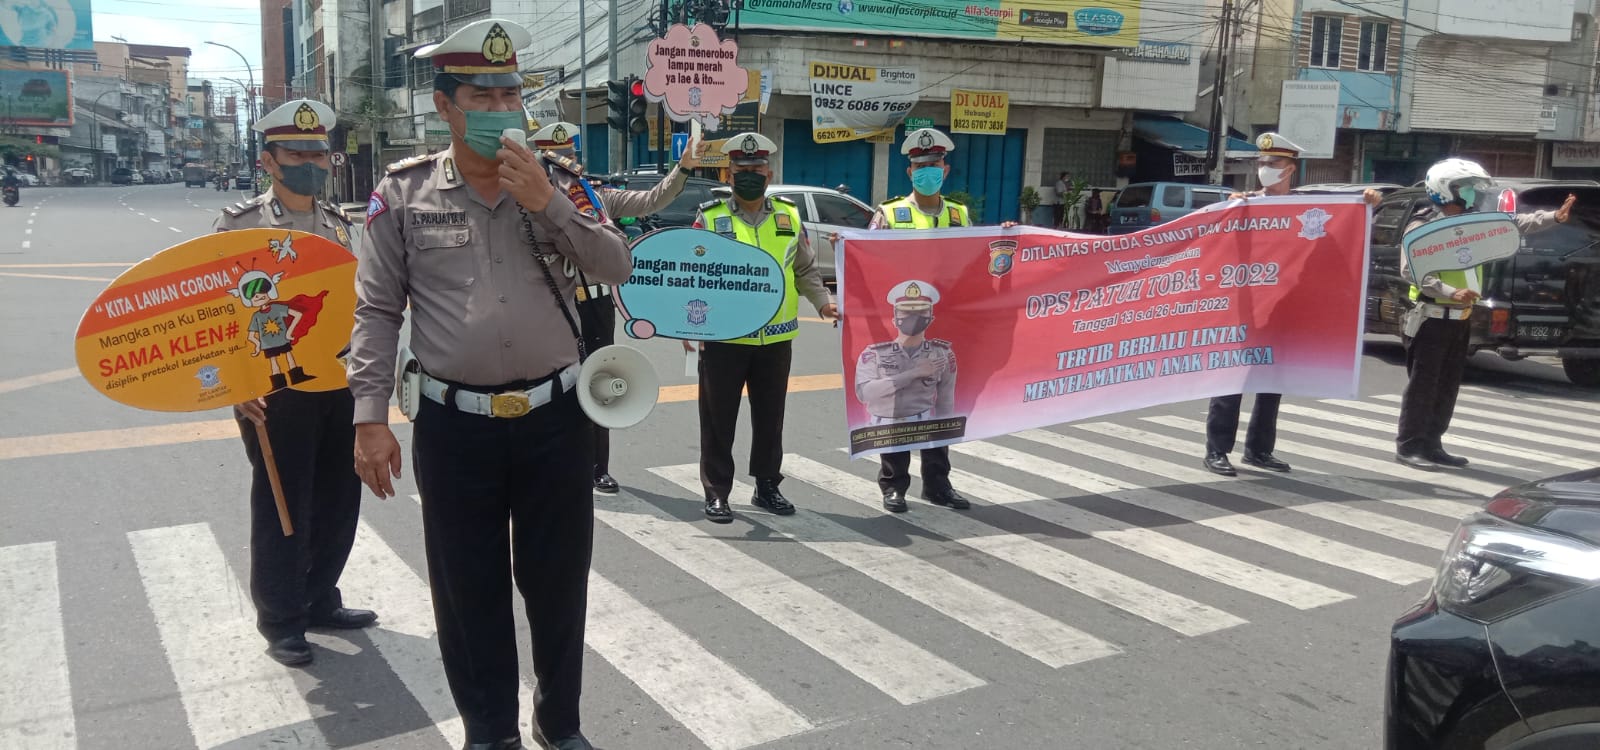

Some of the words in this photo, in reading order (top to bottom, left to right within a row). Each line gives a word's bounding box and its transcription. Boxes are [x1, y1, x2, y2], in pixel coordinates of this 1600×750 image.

[749, 0, 833, 10] @YamahaMesra
[858, 3, 958, 19] www.alfascorpii.co.id
[964, 5, 982, 16] Alfa
[983, 6, 1014, 20] Scorpii
[1033, 16, 1053, 25] Google
[1053, 17, 1066, 26] Play
[1076, 13, 1121, 23] CLASSY
[655, 44, 686, 59] Jangan
[688, 48, 734, 59] menerobos
[668, 59, 695, 72] lampu
[697, 61, 723, 72] merah
[814, 64, 871, 80] DIJUAL
[665, 74, 676, 86] ya
[678, 73, 691, 84] lae
[693, 73, 700, 84] &
[814, 83, 853, 96] LINCE
[815, 98, 845, 109] 0852
[848, 100, 879, 111] 6086
[882, 102, 912, 111] 7669
[955, 93, 970, 106] DI
[973, 94, 1005, 109] JUAL
[964, 110, 991, 118] Hubungi
[1021, 242, 1089, 262] DITLANTAS
[1092, 236, 1141, 253] POLDA
[1143, 227, 1194, 248] SUMUT
[1198, 221, 1222, 237] DAN
[1223, 217, 1292, 234] JAJARAN
[1412, 242, 1445, 258] Jangan
[1446, 231, 1487, 249] melawan
[632, 256, 676, 273] Jangan
[679, 261, 770, 278] menggunakan
[667, 276, 696, 288] saat
[698, 276, 779, 293] berkendara..
[1026, 291, 1071, 319] OPS
[1072, 278, 1146, 313] PATUH
[1147, 269, 1201, 298] TOBA
[1219, 262, 1279, 289] 2022
[105, 297, 135, 318] KITA
[134, 284, 179, 310] LAWAN
[180, 269, 232, 297] CORONA
[1073, 312, 1119, 333] Tanggal
[1120, 309, 1135, 325] 13
[1154, 303, 1170, 319] 26
[1170, 301, 1198, 316] Juni
[1199, 297, 1230, 311] 2022
[99, 327, 151, 349] Mangka
[153, 320, 177, 335] nya
[177, 313, 195, 327] Ku
[197, 303, 236, 321] Bilang
[99, 343, 164, 377] SAMA
[169, 320, 240, 357] KLEN#
[1056, 342, 1115, 371] TERTIB
[1117, 330, 1188, 359] BERLALU
[1190, 324, 1248, 347] LINTAS
[105, 374, 139, 390] disiplin
[141, 360, 180, 382] protokol
[182, 349, 226, 367] kesehatan
[1023, 359, 1156, 402] MENYELAMATKAN
[1159, 353, 1204, 377] ANAK
[1207, 345, 1274, 370] BANGSA
